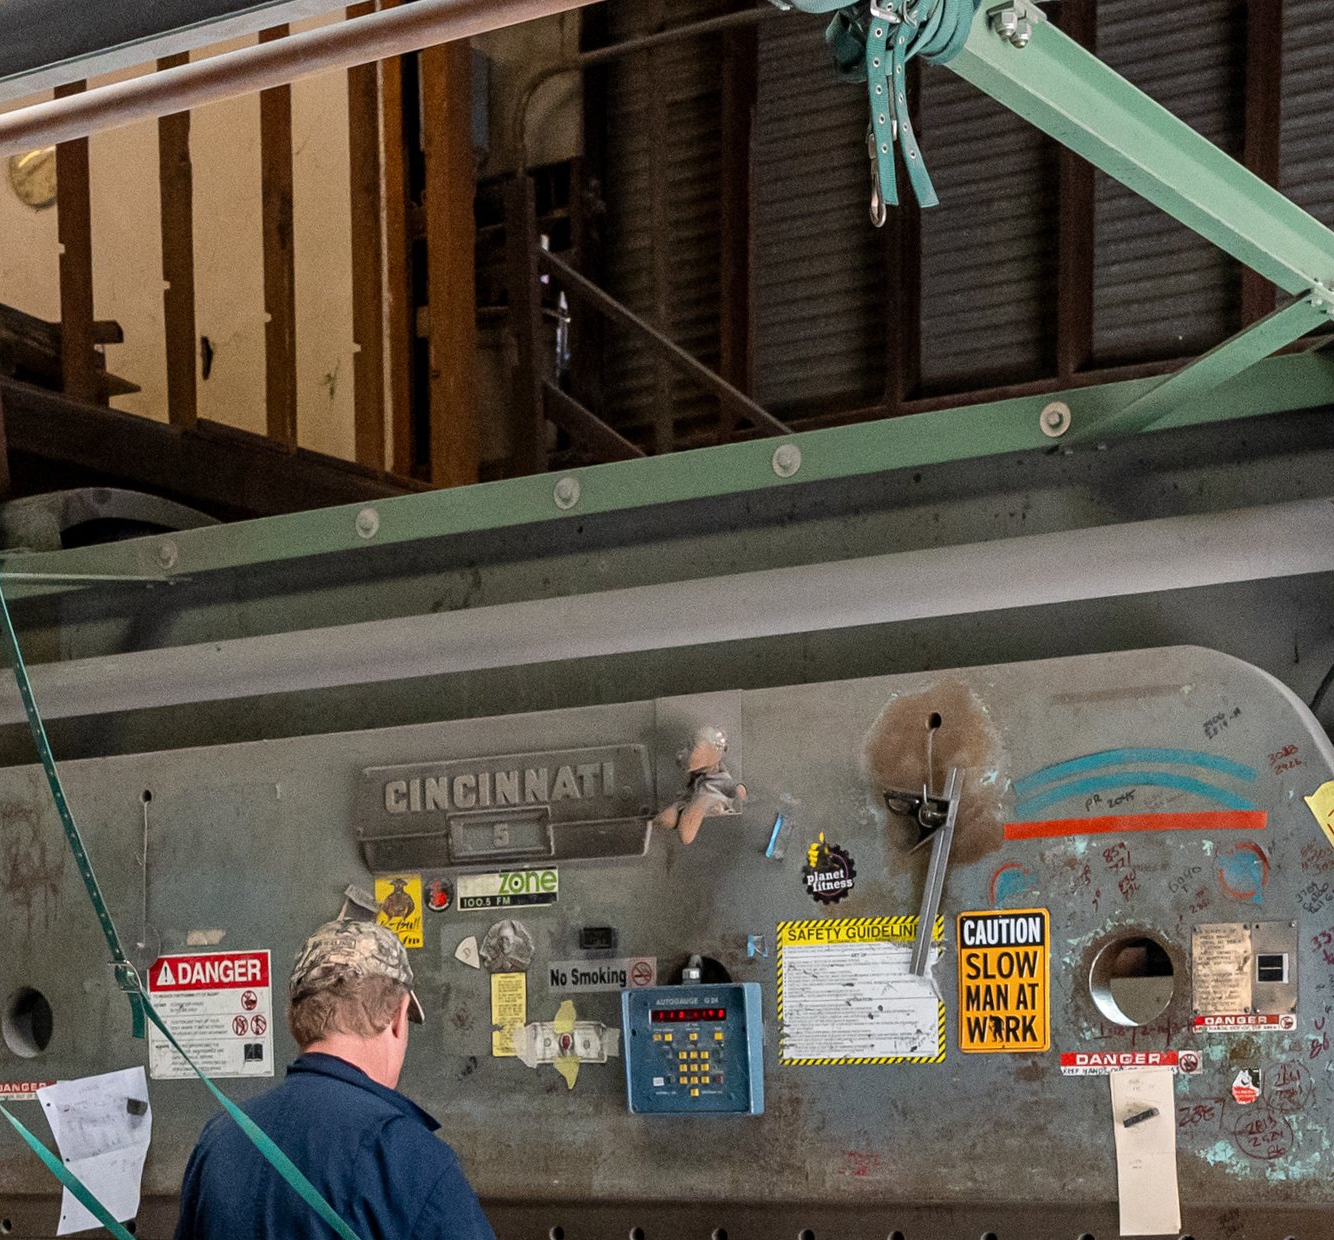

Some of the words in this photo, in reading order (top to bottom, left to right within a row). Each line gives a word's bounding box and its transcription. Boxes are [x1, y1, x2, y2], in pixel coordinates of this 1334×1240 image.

[385, 762, 615, 814] CINCINNATI
[498, 871, 557, 894] zone
[807, 868, 844, 885] planet
[812, 879, 853, 892] fitness
[463, 898, 492, 907] 100.5
[496, 896, 511, 905] FM
[788, 926, 841, 941] SAFETY
[846, 924, 918, 939] GUIDELIN
[963, 917, 1041, 945] CAUTION
[177, 959, 262, 985] DANGER
[966, 951, 1038, 980] SLOW
[550, 969, 568, 986] No
[571, 967, 627, 987] Smoking
[966, 984, 1009, 1011] MAN
[1016, 983, 1039, 1010] AT
[967, 1014, 1038, 1043] WRK
[1204, 1016, 1268, 1025] DANGER
[1076, 1053, 1161, 1065] DANGER
